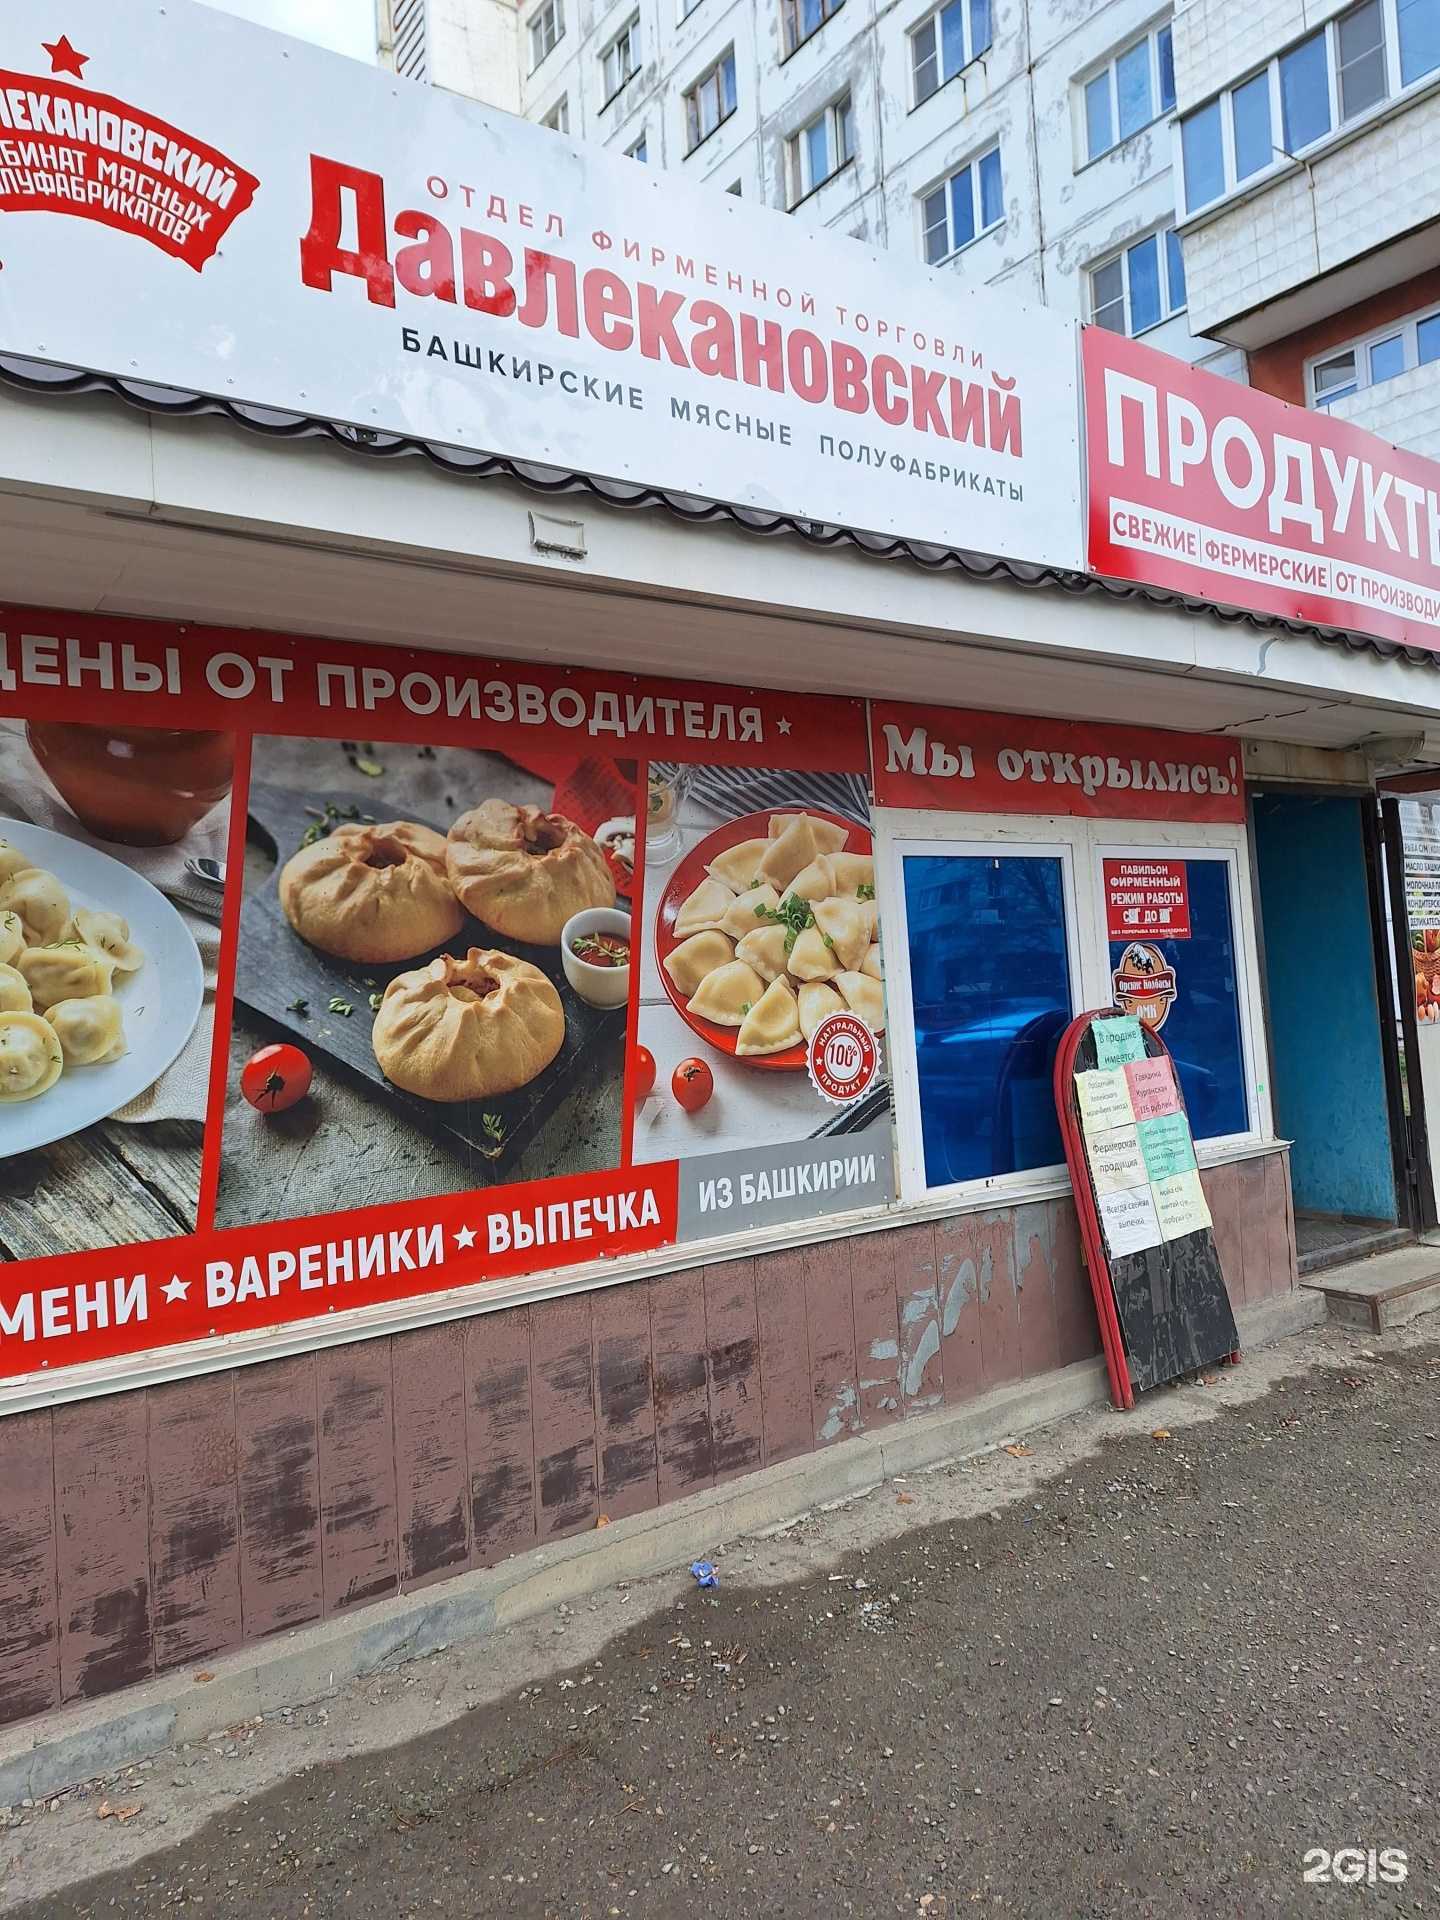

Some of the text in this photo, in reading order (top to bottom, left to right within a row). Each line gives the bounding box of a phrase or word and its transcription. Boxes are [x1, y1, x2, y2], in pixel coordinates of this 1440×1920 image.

[98, 157, 212, 232] МЯСНЫХ
[299, 152, 1024, 458] Давлекановский
[427, 175, 984, 369] ОТДЕЛ ФИРМЕННОЙ ТОРГОВЛИ
[402, 326, 1024, 502] БАШКИРСКИЕ МЯСНЫЕ ПОЛУФАБРИКАТЫ
[1112, 511, 1196, 556] СВЕЖИЕ
[1205, 539, 1327, 588] ФЕРМЕРСКИЕ
[1335, 571, 1358, 593] ОТ
[205, 652, 294, 703] ОТ
[317, 663, 764, 743] ПРОИЗВОДИТЕЛЯ
[882, 724, 1239, 797] Мы открылись!
[1110, 876, 1180, 887] ФИРМЕННЫЙ
[1111, 892, 1184, 904] РЕЖИМ РАБОТЫ
[1120, 865, 1168, 875] ПАВИЛЬОН
[1145, 910, 1157, 923] ДО
[819, 1022, 871, 1052] НАТУРАЛЬНЫЙ
[821, 1073, 861, 1096] ПРОДУКТ
[699, 1154, 876, 1213] ИЗ БАШКИРИИ
[205, 1223, 444, 1308] ВАРЕНИКИ
[487, 1188, 661, 1254] ВЫПЕЧКА
